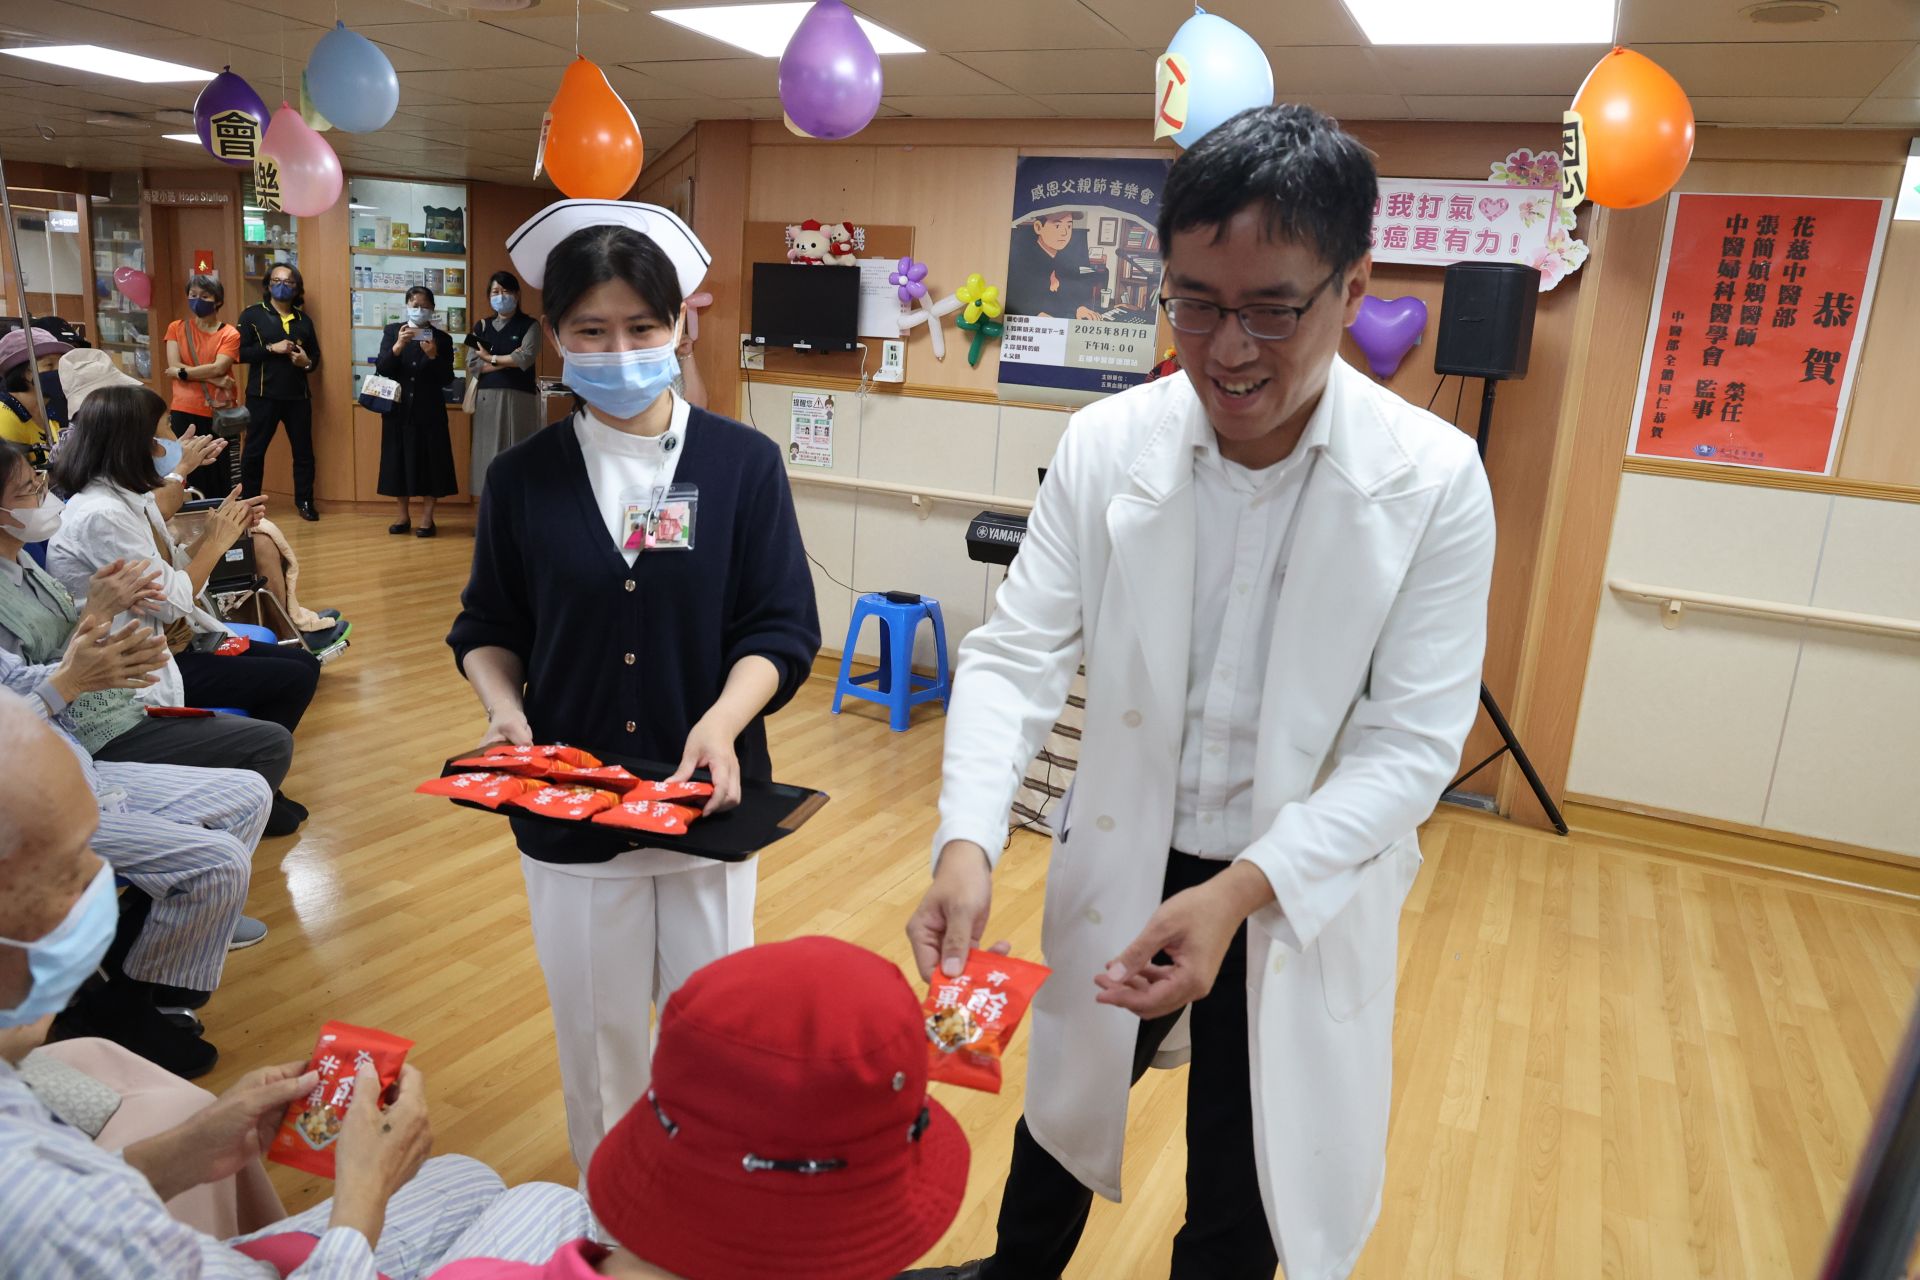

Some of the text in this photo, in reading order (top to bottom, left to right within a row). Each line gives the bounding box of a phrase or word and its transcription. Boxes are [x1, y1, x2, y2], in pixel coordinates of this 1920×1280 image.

[211, 112, 258, 157] 會
[200, 191, 229, 202] Station
[1031, 177, 1155, 205] 感恩父親節音樂會
[1772, 215, 1816, 328] 花慈中醫部
[1075, 325, 1147, 339] 2025年8月7日
[1692, 213, 1749, 419] 中醫婦科醫學會 監事
[1651, 310, 1685, 439] 中醫部全體同仁恭賀
[1721, 382, 1746, 422] 榮任
[989, 527, 1026, 543] YAMAHA
